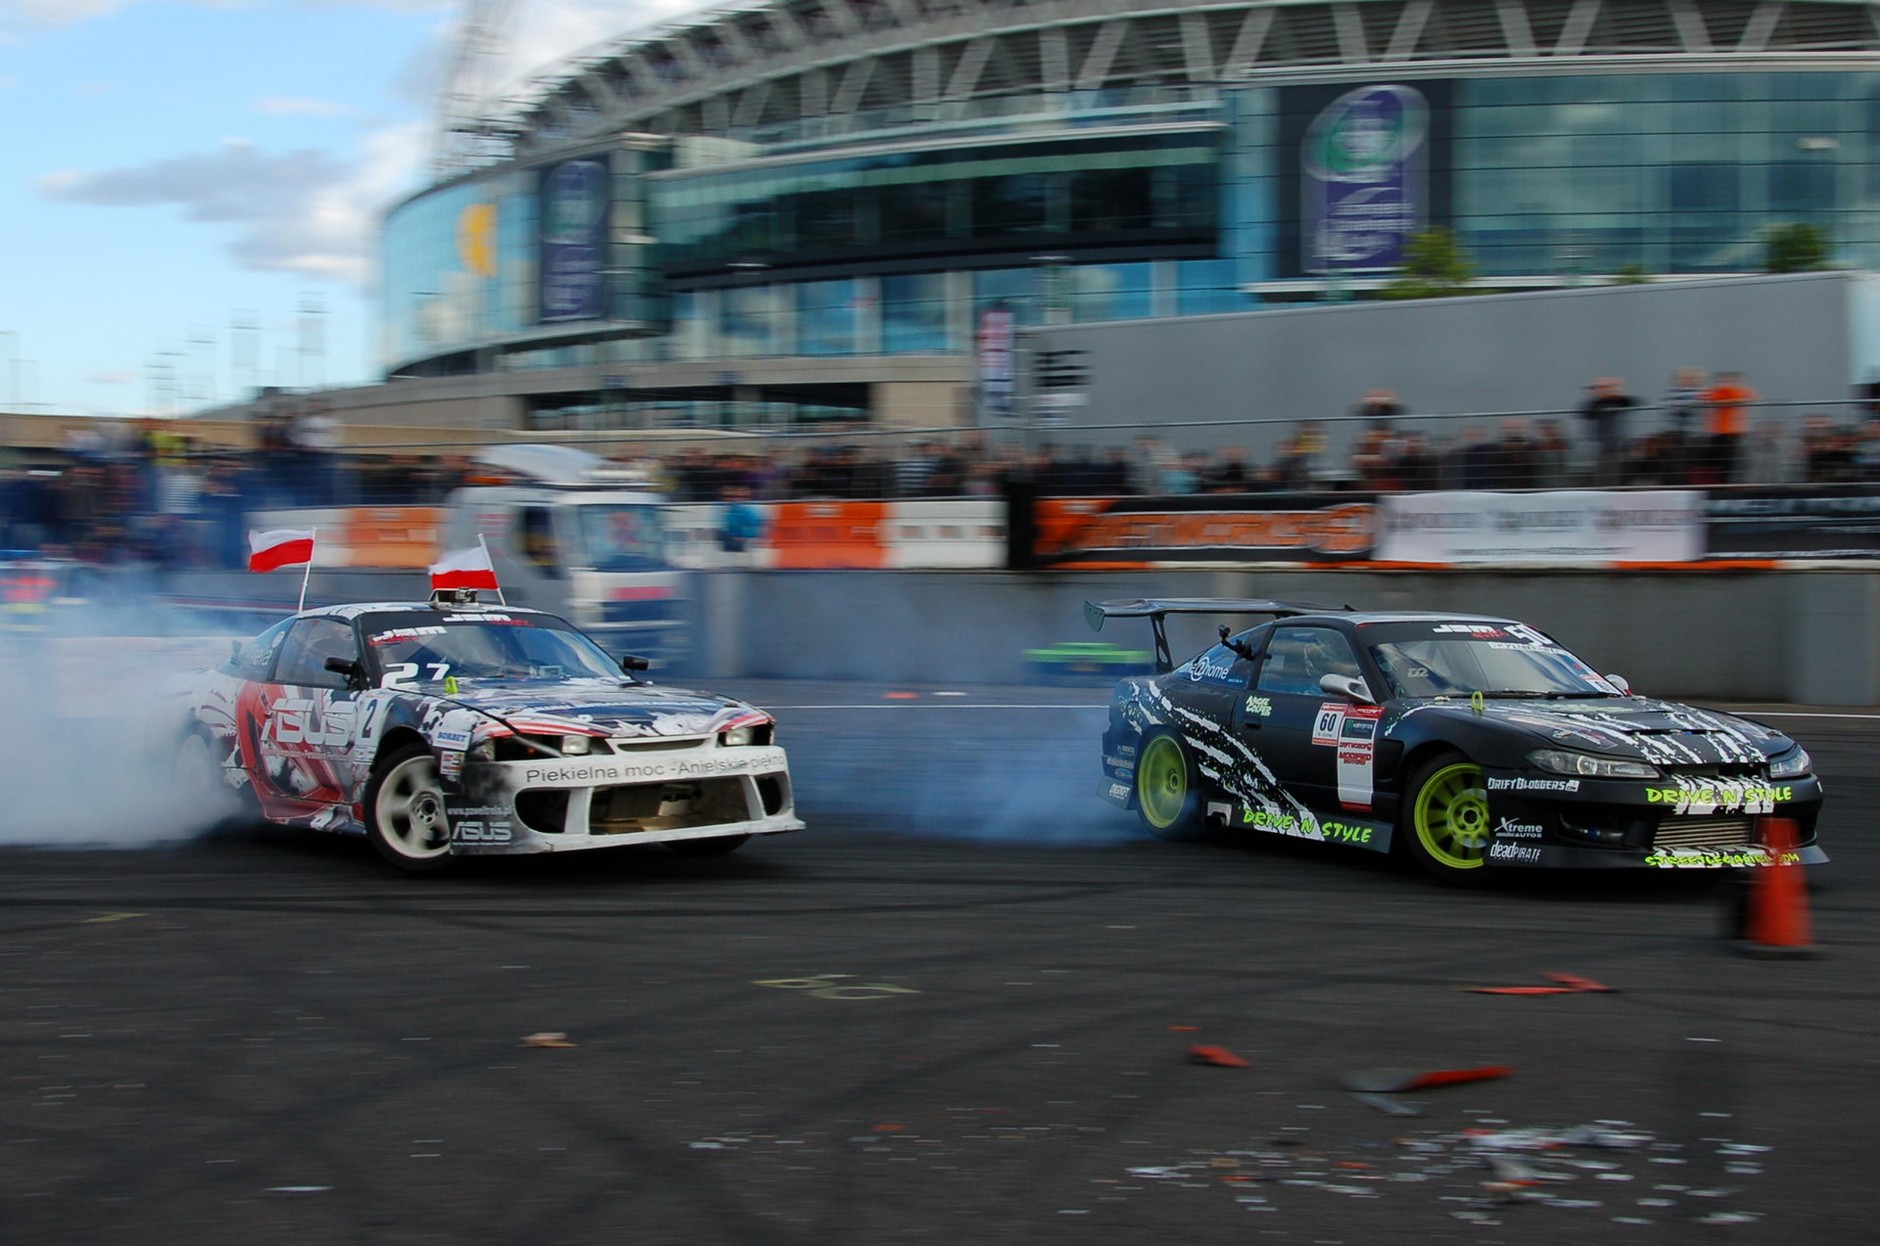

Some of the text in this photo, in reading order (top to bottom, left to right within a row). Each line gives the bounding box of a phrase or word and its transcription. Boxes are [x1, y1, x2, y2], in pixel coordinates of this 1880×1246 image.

[260, 698, 357, 746] ASUS
[1320, 713, 1337, 733] 60
[526, 765, 618, 783] Piekielna
[625, 764, 665, 777] moc
[1646, 787, 1792, 803] DRIVE N STYLE
[452, 821, 511, 840] ASUS
[1243, 808, 1372, 843] DRIVE N STYLE
[1494, 817, 1543, 834] Xtreme
